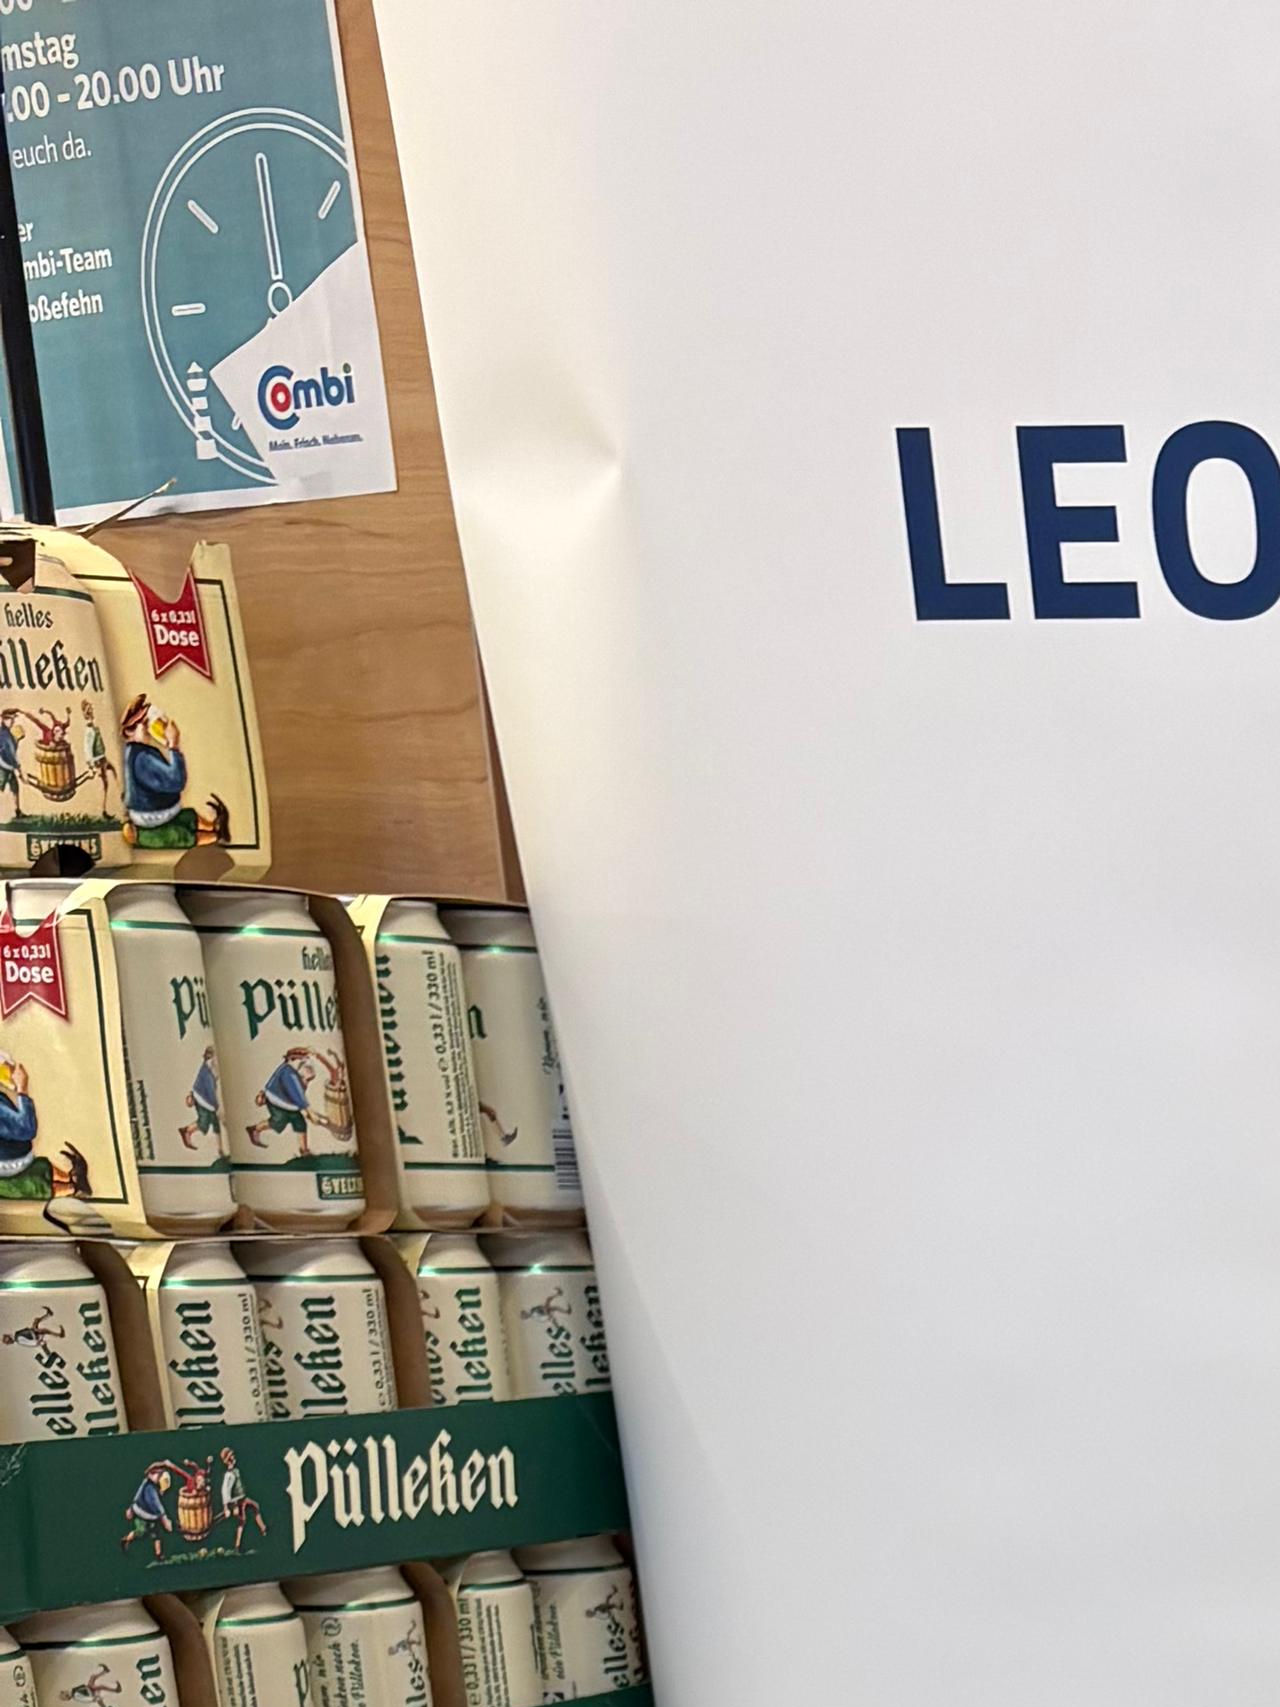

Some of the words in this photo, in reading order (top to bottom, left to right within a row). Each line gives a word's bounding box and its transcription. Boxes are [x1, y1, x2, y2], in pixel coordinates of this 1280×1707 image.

[74, 63, 161, 110] 20.00
[168, 56, 225, 95] Uhr
[12, 134, 58, 169] euch
[63, 131, 92, 161] da.
[258, 362, 355, 430] Combi
[6, 602, 53, 630] helles
[155, 624, 200, 647] Dose
[5, 961, 54, 984] Dose
[283, 1428, 519, 1555] Pülleken
